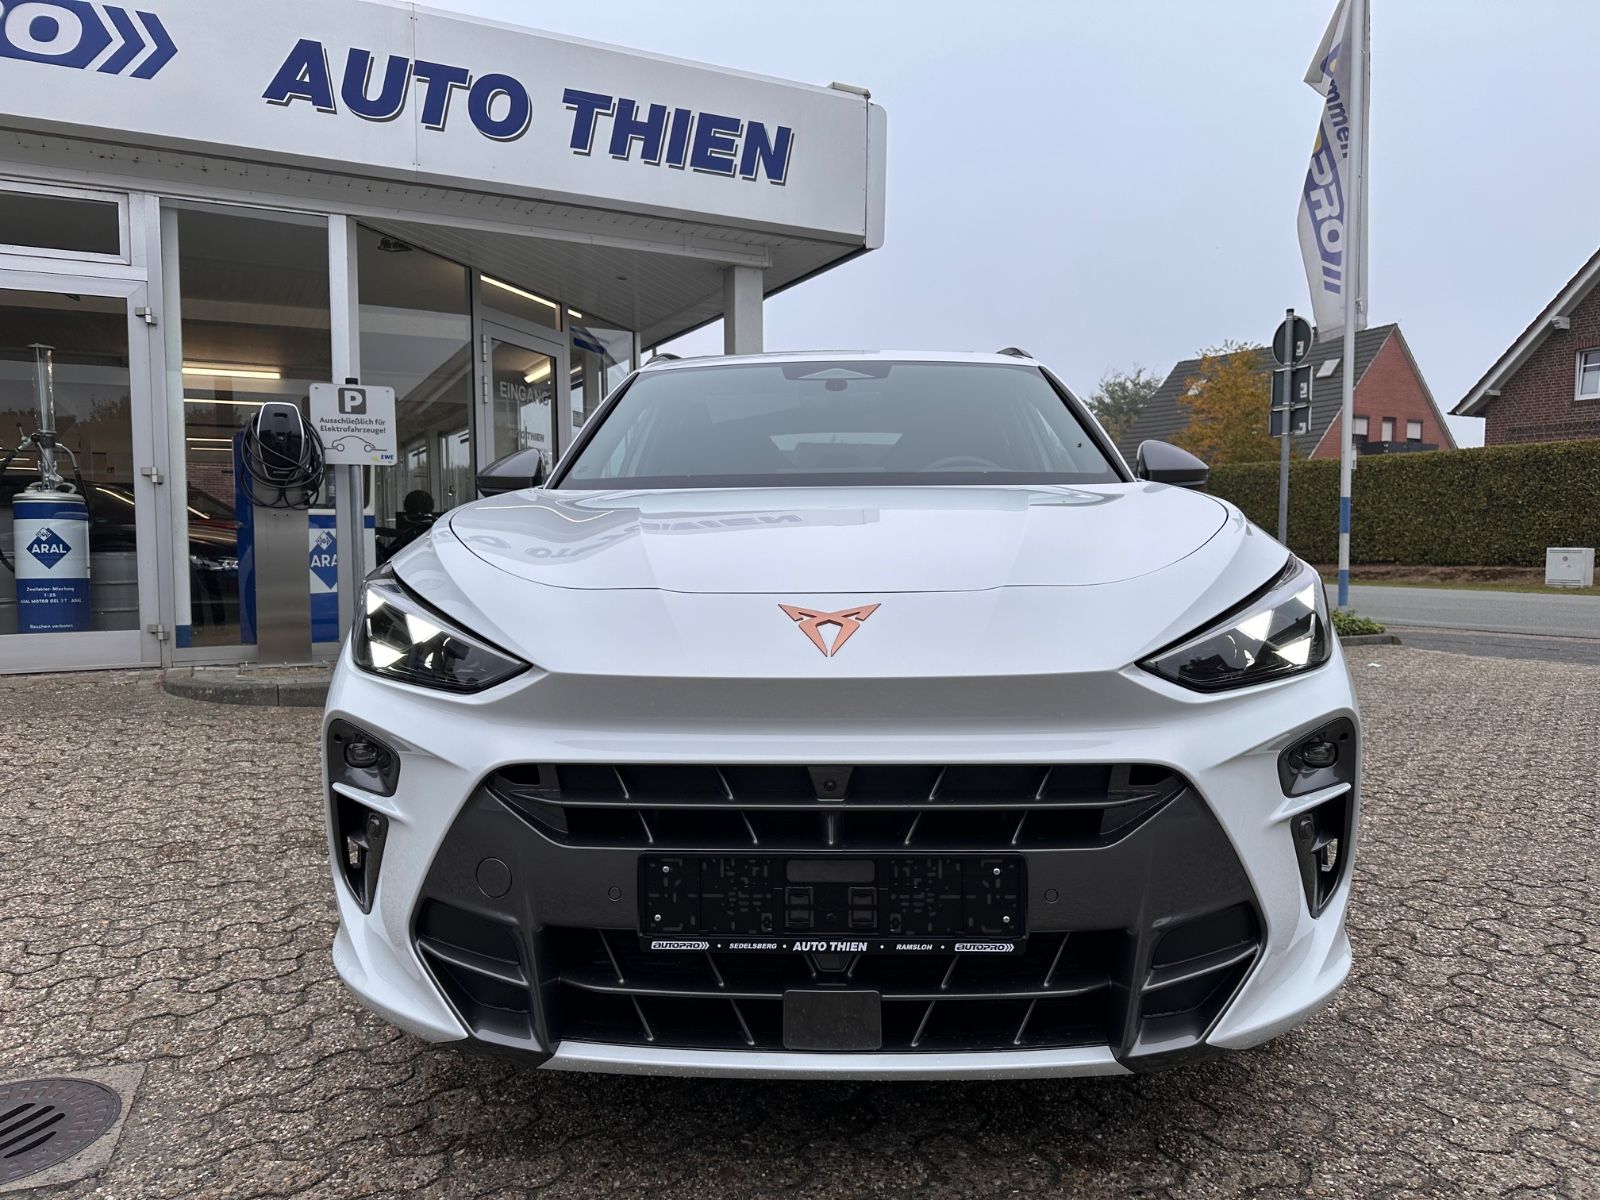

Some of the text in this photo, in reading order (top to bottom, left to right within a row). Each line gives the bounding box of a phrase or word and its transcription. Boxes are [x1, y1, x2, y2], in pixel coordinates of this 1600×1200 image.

[0, 1, 83, 56] O
[262, 38, 796, 186] AUTO THIEN
[1326, 79, 1350, 159] mme
[344, 390, 363, 413] P
[499, 380, 551, 406] EINGANG
[319, 417, 386, 426] Ausschließlich für
[320, 425, 386, 435] Elektrofahrzeuge!
[32, 544, 66, 554] ARAL
[311, 554, 337, 568] ARA
[793, 941, 827, 951] AUTO
[829, 941, 868, 952] THIEN
